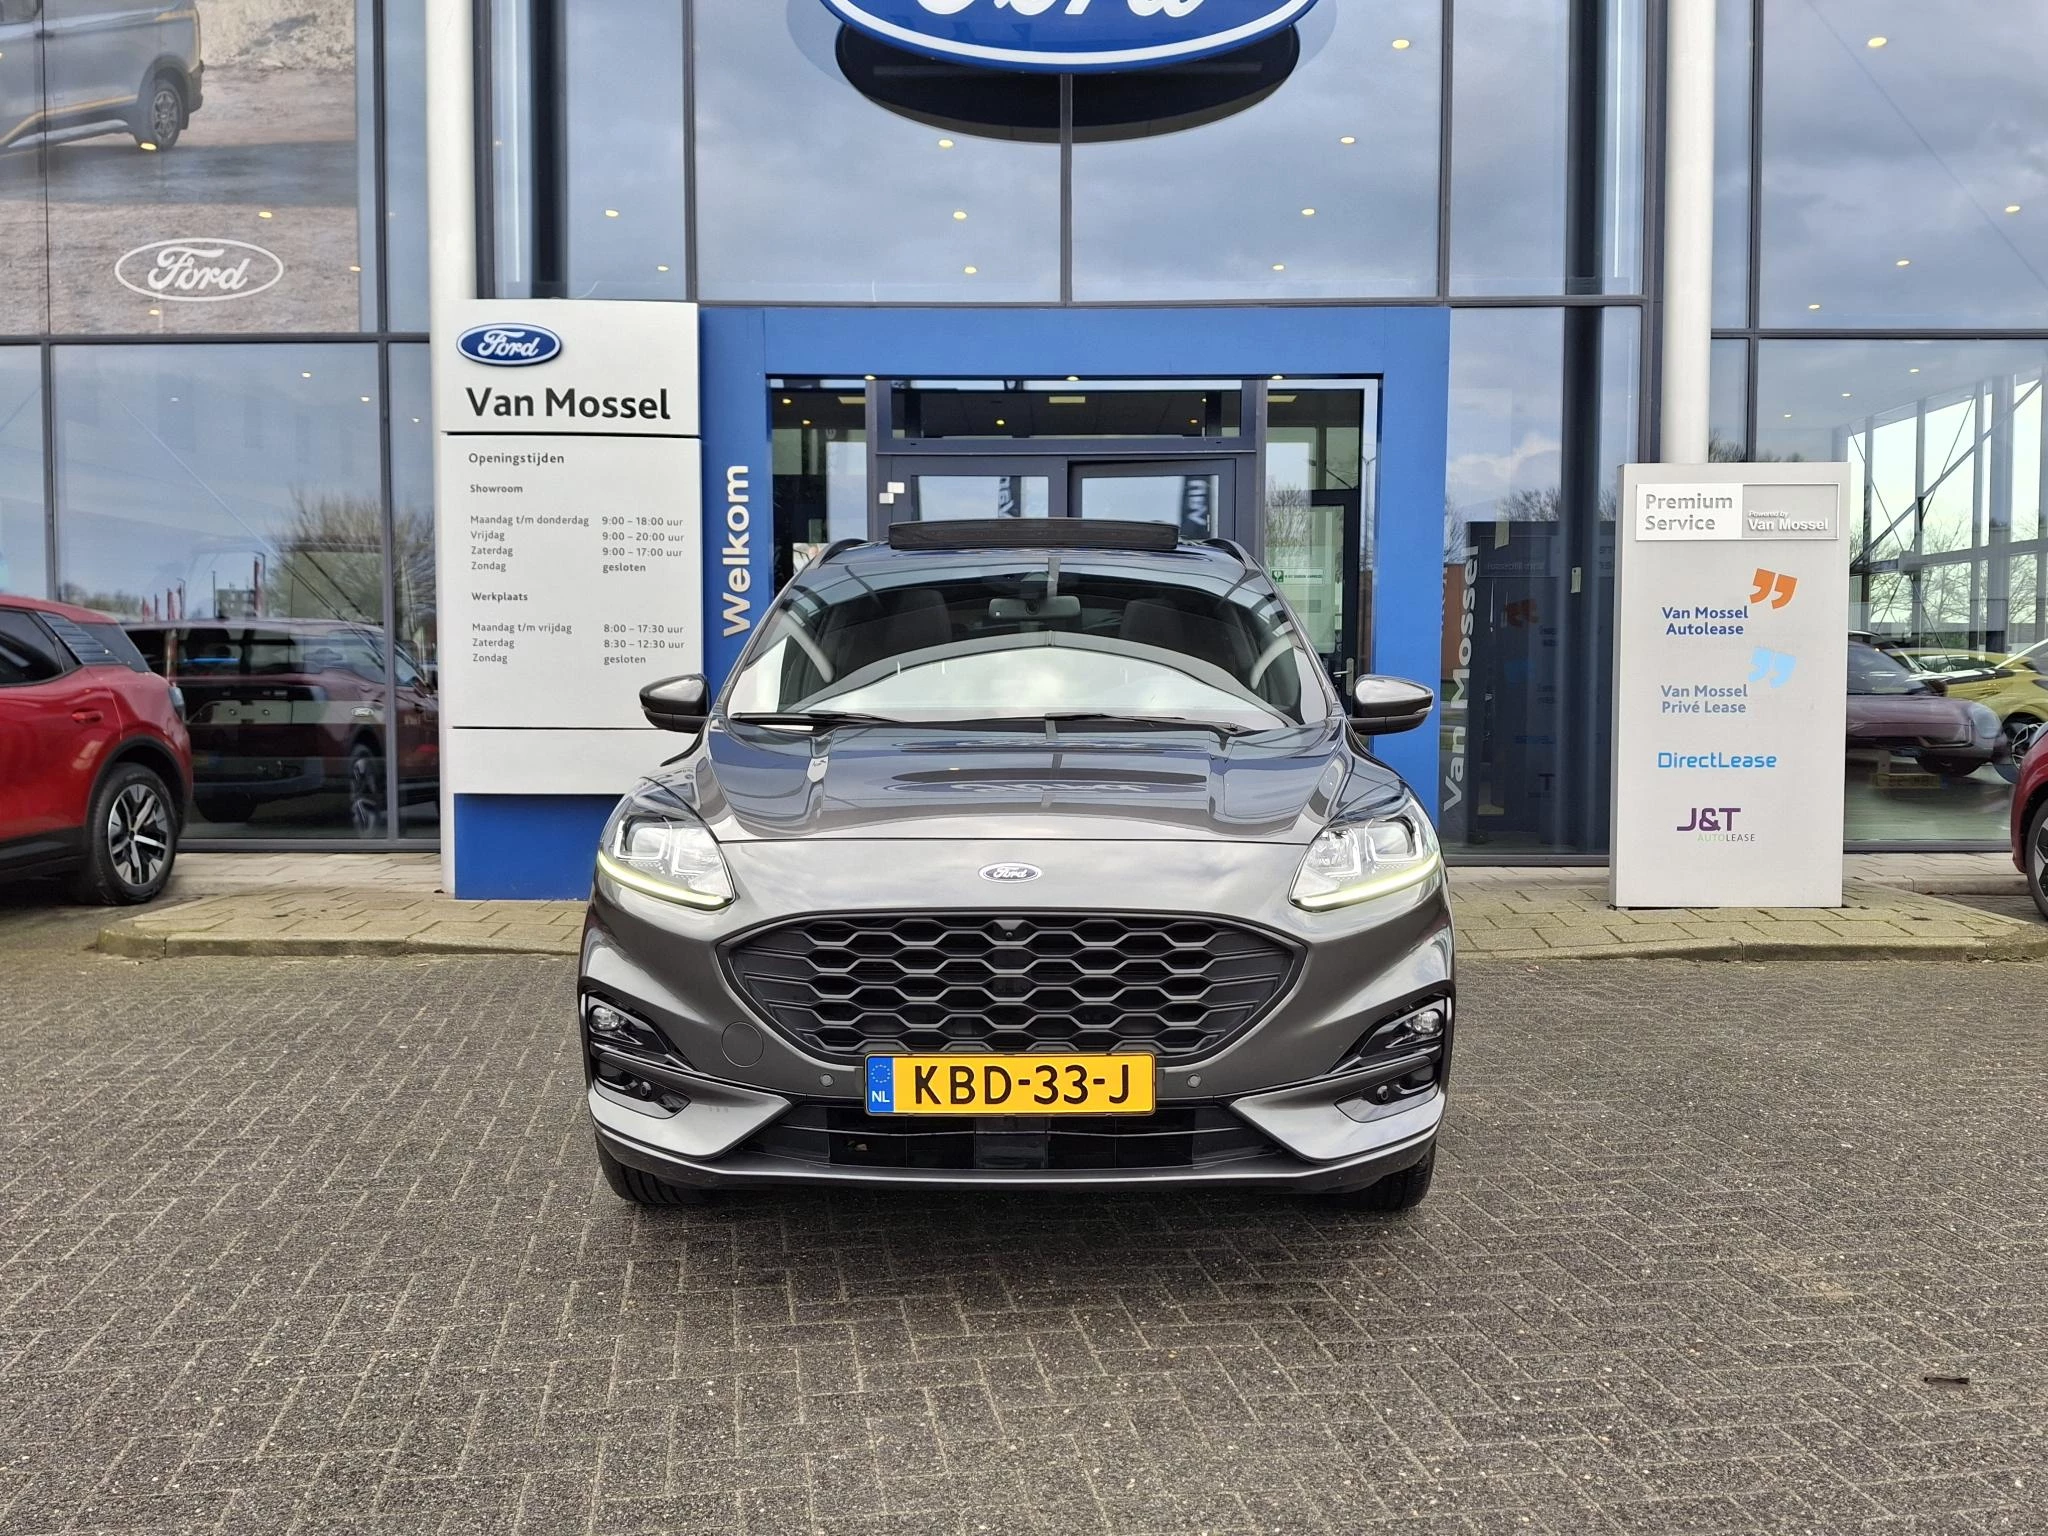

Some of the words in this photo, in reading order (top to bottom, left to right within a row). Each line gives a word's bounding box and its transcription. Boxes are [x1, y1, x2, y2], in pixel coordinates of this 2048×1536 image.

[148, 247, 250, 289] Ford
[477, 330, 540, 357] Ford
[466, 388, 534, 416] Van
[546, 388, 671, 420] Mossel
[469, 453, 564, 466] Openingstijden
[470, 484, 523, 493] Showroom
[1645, 492, 1733, 510] Premium
[471, 515, 513, 526] Maandag
[516, 515, 534, 525] t/m
[537, 515, 589, 527] donderdag
[602, 516, 624, 525] 9:00
[636, 517, 664, 526] 18:00
[1645, 515, 1716, 531] Service
[1749, 519, 1775, 531] Van
[1779, 518, 1829, 531] Mossel
[471, 531, 505, 542] Vrijdag
[602, 532, 625, 541] 9:00
[636, 532, 665, 541] 20:00
[668, 534, 684, 542] uur
[471, 546, 513, 557] Zaterdag
[603, 547, 625, 556] 9:00
[637, 548, 663, 556] 17:00
[667, 549, 683, 557] uur
[722, 465, 750, 637] Welkom
[471, 561, 506, 572] Zondag
[603, 563, 646, 573] gesloten
[472, 592, 528, 603] Werkplaats
[1662, 607, 1690, 619] Van
[1695, 606, 1749, 619] Mossel
[472, 623, 515, 634] Maandag
[518, 623, 536, 632] t/m
[539, 624, 572, 634] vrijdag
[604, 624, 626, 633] 8:00
[638, 625, 664, 633] 17:30
[667, 626, 683, 634] uur
[1450, 544, 1479, 710] Mossel
[1665, 622, 1744, 635] Autolease
[472, 638, 514, 649] Zaterdag
[604, 640, 626, 648] 8:30
[638, 640, 665, 649] 12:30
[473, 654, 507, 664] Zondag
[604, 655, 646, 665] gesloten
[1661, 685, 1689, 697] Van
[1694, 684, 1748, 698] Mossel
[1662, 701, 1700, 713] Privé
[1704, 701, 1746, 714] Lease
[1658, 752, 1777, 768] DirectLease
[1443, 725, 1467, 812] Van
[1677, 808, 1741, 832] J&T
[1697, 833, 1755, 842] AUTOLEASE
[993, 866, 1027, 878] Ford
[914, 1064, 1129, 1105] KBD-33-J
[871, 1091, 890, 1103] NL
